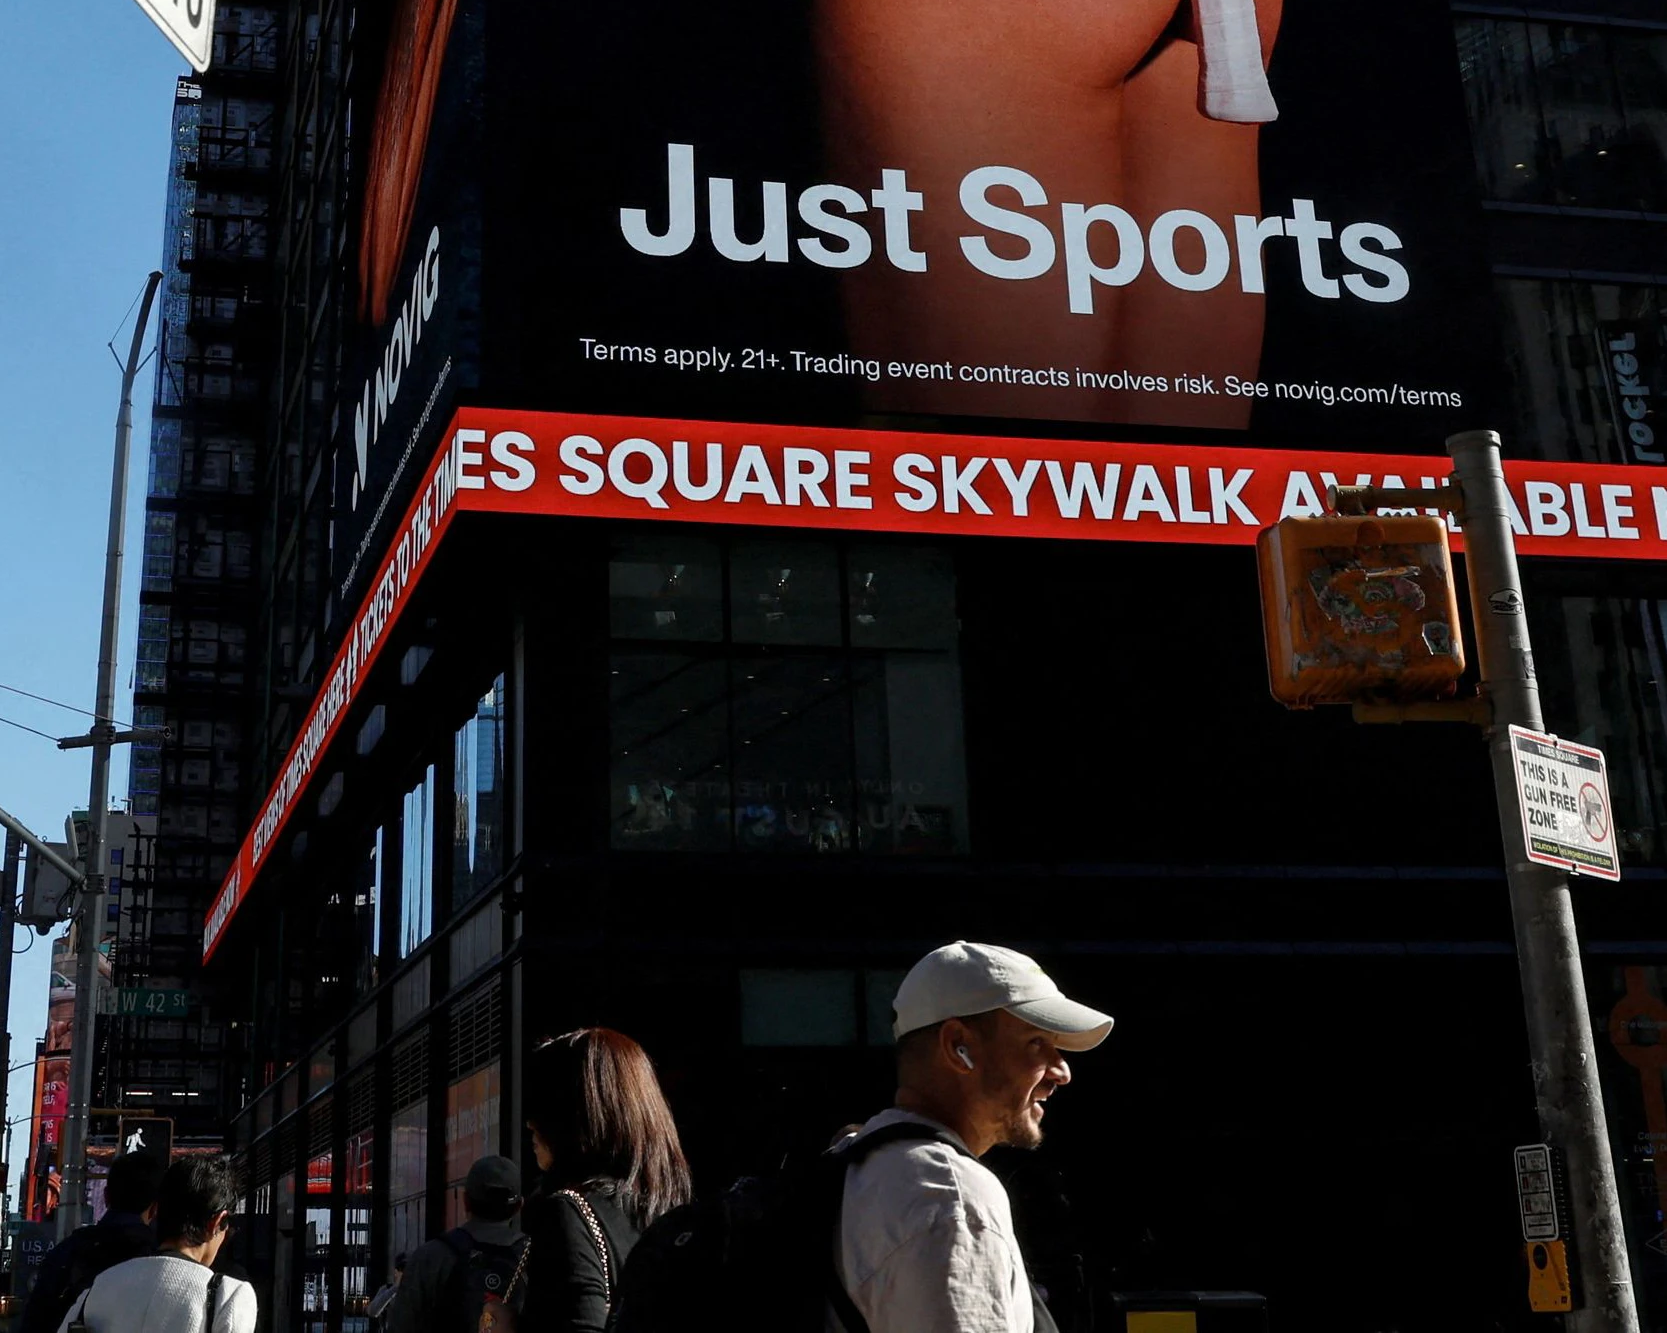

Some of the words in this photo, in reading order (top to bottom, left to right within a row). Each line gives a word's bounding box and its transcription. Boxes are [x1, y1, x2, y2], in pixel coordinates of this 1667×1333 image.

[620, 142, 927, 273] Just
[958, 164, 1410, 314] Sports
[374, 226, 440, 445] NOVIG
[580, 338, 656, 363] Terms
[664, 346, 735, 373] apply.
[741, 349, 785, 371] 21+.
[790, 351, 880, 381] Trading
[887, 360, 953, 380] event
[959, 364, 1070, 387] contracts
[1075, 367, 1168, 393] involves
[1174, 373, 1220, 395] risk.
[1224, 376, 1269, 398] See
[1275, 379, 1462, 407] novig.com/terms
[361, 559, 395, 667] TICKETS
[396, 530, 411, 598] TO
[411, 482, 432, 570] THE
[558, 435, 873, 509] SQUARE
[892, 452, 1261, 526] SKYWALK
[1280, 470, 1641, 541] AABLE
[302, 694, 327, 774] SQUARE
[326, 657, 345, 731] HERE
[1521, 760, 1546, 782] THIS
[1547, 767, 1559, 786] IS
[1562, 772, 1569, 789] A
[1537, 745, 1556, 758] TIMES
[1556, 749, 1580, 765] SQUARE
[1524, 784, 1548, 805] GUN
[1549, 791, 1578, 813] FREE
[1528, 807, 1558, 830] ZONE
[122, 992, 138, 1012] W
[145, 993, 165, 1013] 42
[173, 993, 186, 1007] St
